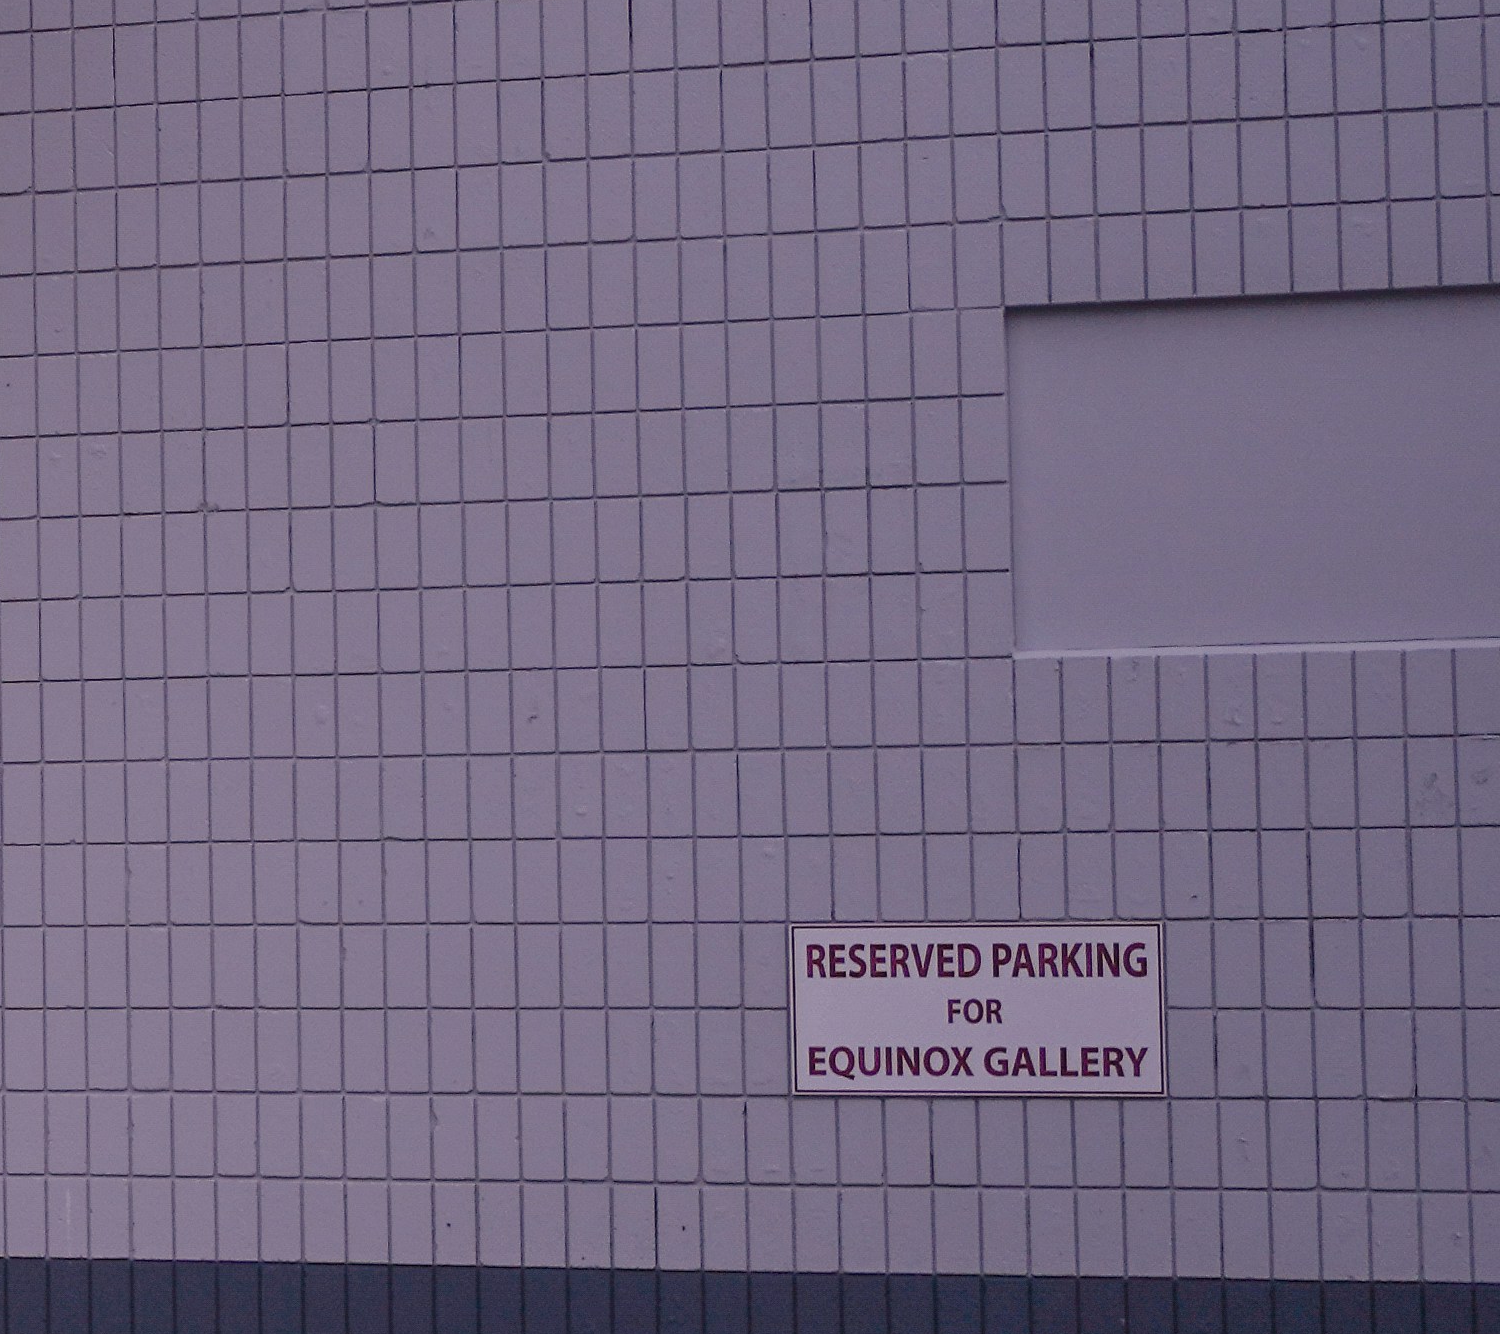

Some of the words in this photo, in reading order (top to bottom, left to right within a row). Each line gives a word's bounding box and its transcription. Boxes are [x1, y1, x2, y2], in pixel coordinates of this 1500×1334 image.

[806, 942, 982, 979] RESERVED
[992, 941, 1148, 978] PARKING
[947, 998, 1003, 1025] FOR
[808, 1045, 975, 1081] EQUINOX
[983, 1046, 1149, 1078] GALLERY
